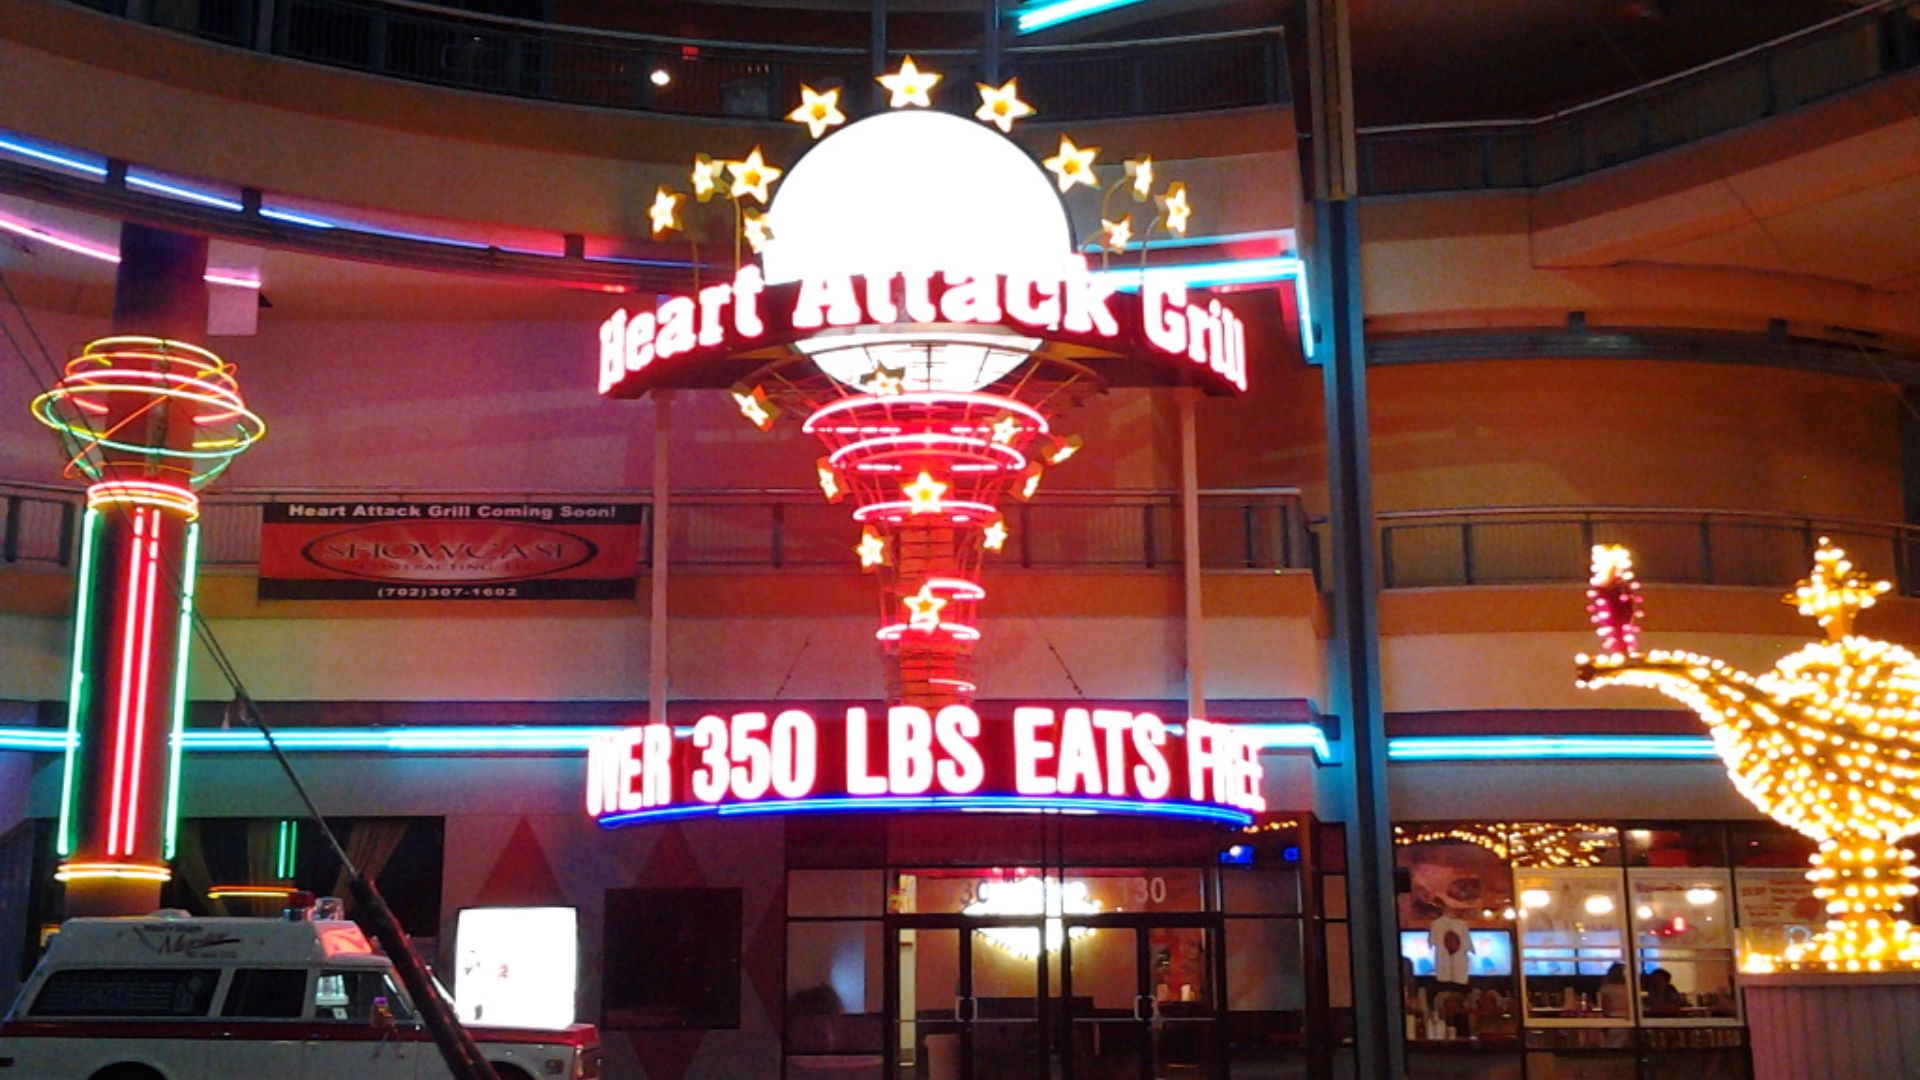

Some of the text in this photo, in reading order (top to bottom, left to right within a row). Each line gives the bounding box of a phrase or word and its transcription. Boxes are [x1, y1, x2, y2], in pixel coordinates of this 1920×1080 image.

[598, 256, 1248, 394] Heart Attack Grill
[288, 504, 617, 520] Heart Attack Grill Coming Soon!
[377, 587, 518, 599] (702)307-1602
[692, 711, 817, 803] 350
[845, 706, 985, 795] LBS
[1013, 706, 1172, 800] EATS
[1186, 718, 1266, 812] FREE
[1118, 877, 1167, 904] 130
